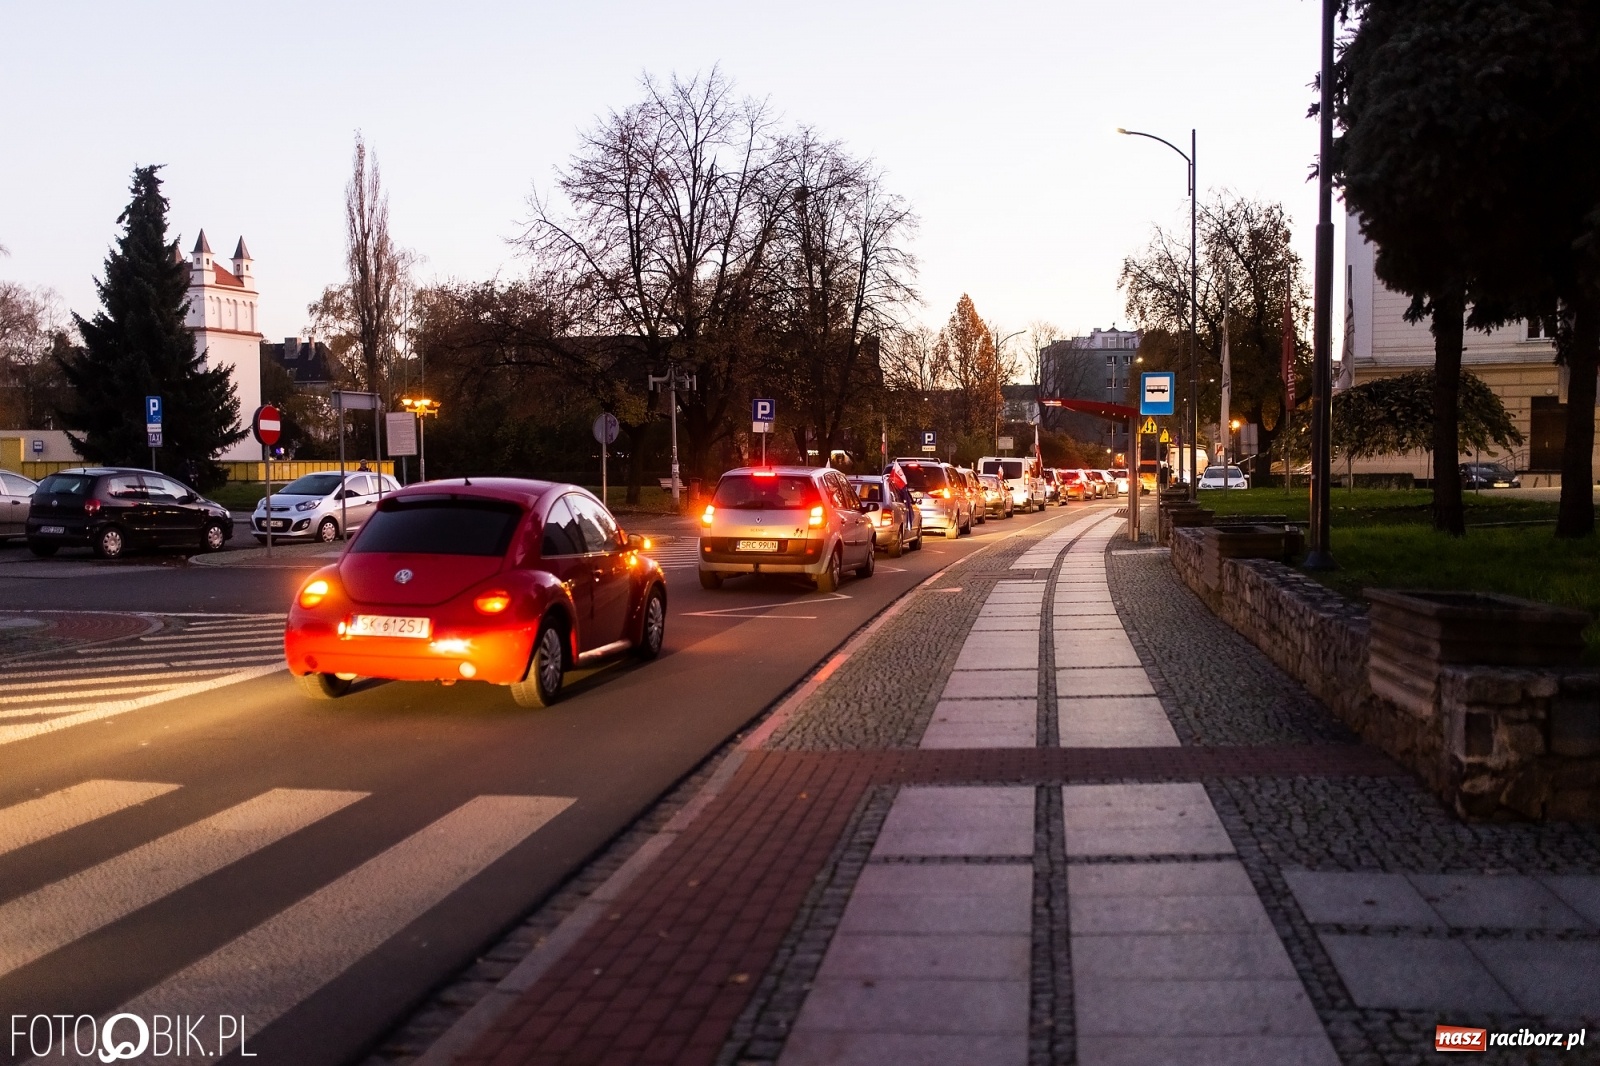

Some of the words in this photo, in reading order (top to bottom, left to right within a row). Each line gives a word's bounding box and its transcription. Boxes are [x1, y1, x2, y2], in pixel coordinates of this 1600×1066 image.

[150, 399, 159, 415] P
[757, 402, 771, 419] P
[148, 433, 162, 442] TAXI
[925, 432, 934, 444] P
[741, 541, 757, 549] SRC
[360, 617, 377, 631] SK
[382, 618, 425, 634] 612SJ
